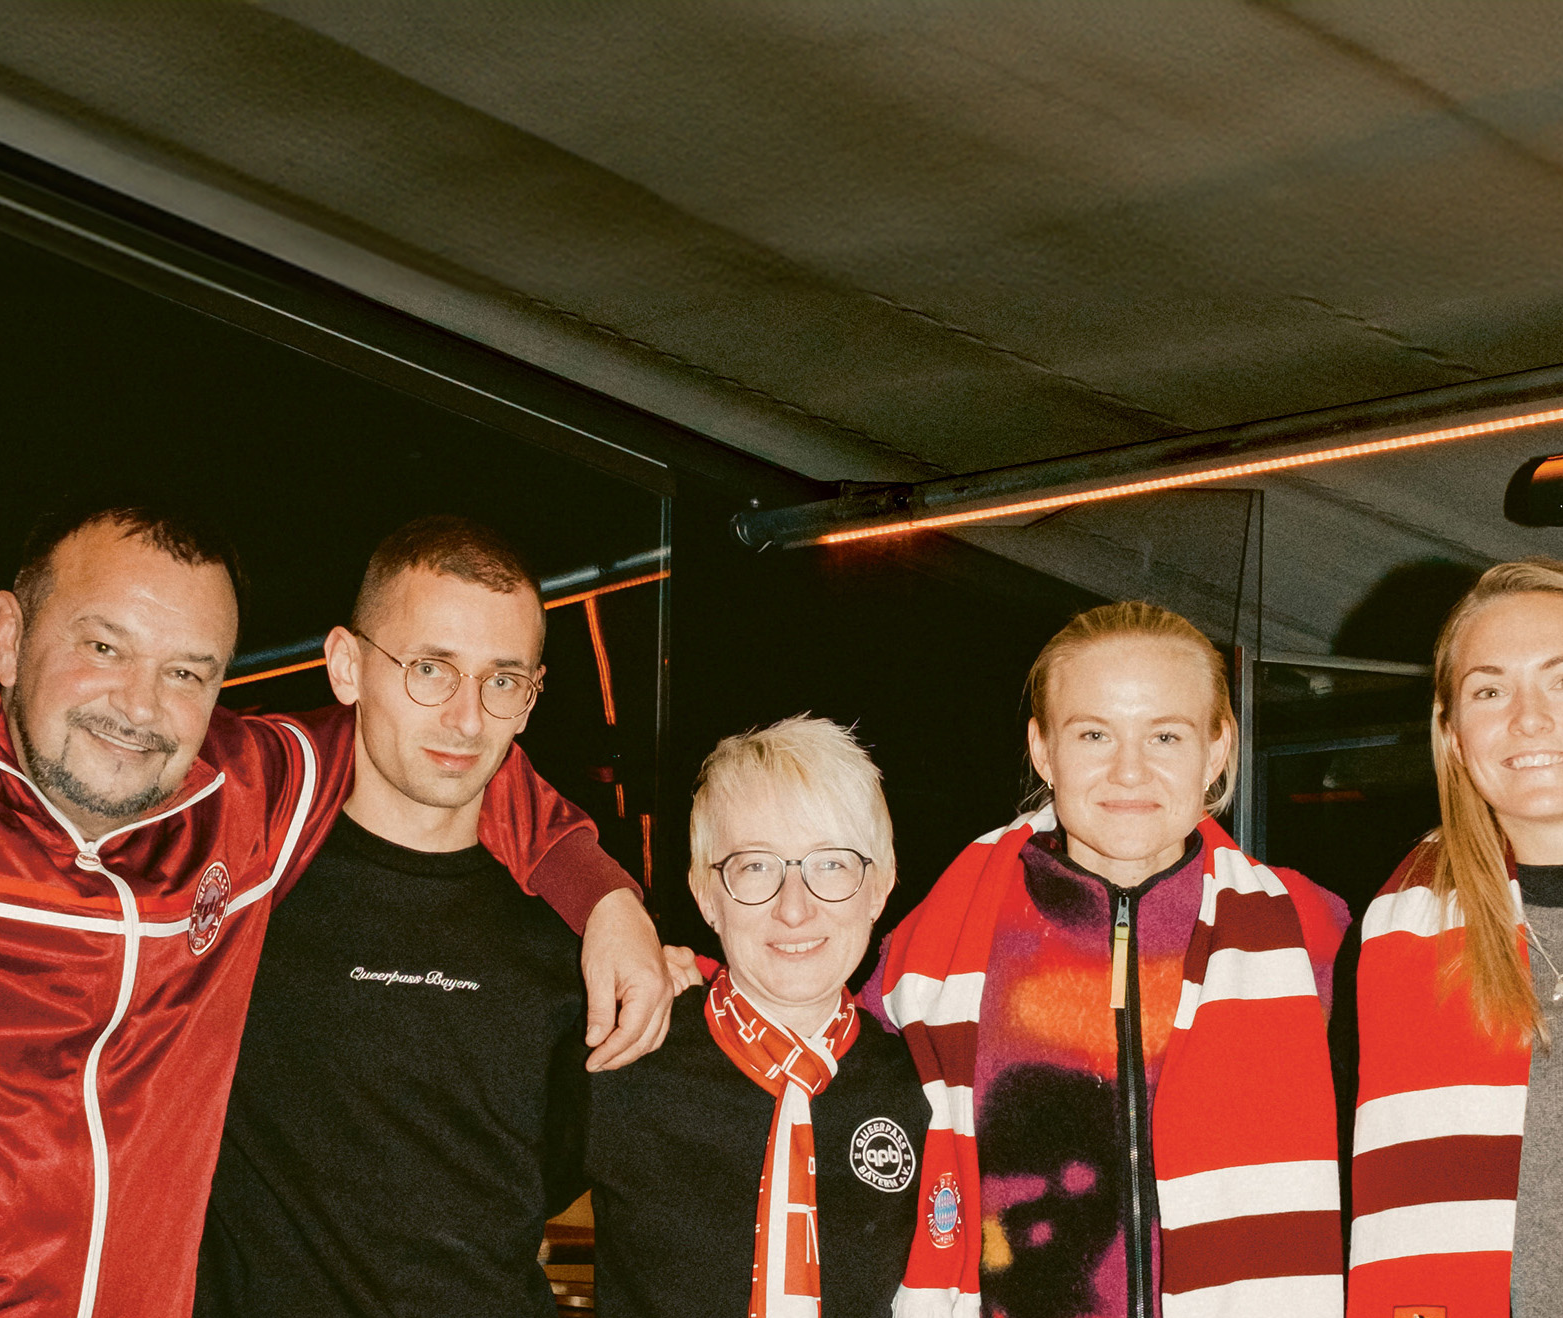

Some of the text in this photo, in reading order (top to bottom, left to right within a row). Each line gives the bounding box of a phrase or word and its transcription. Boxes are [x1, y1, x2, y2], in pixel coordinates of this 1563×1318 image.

[349, 966, 481, 992] Queerpass Bayern
[856, 1122, 907, 1150] QUEERPASS
[866, 1145, 899, 1167] qpb
[858, 1165, 899, 1188] BAYERN
